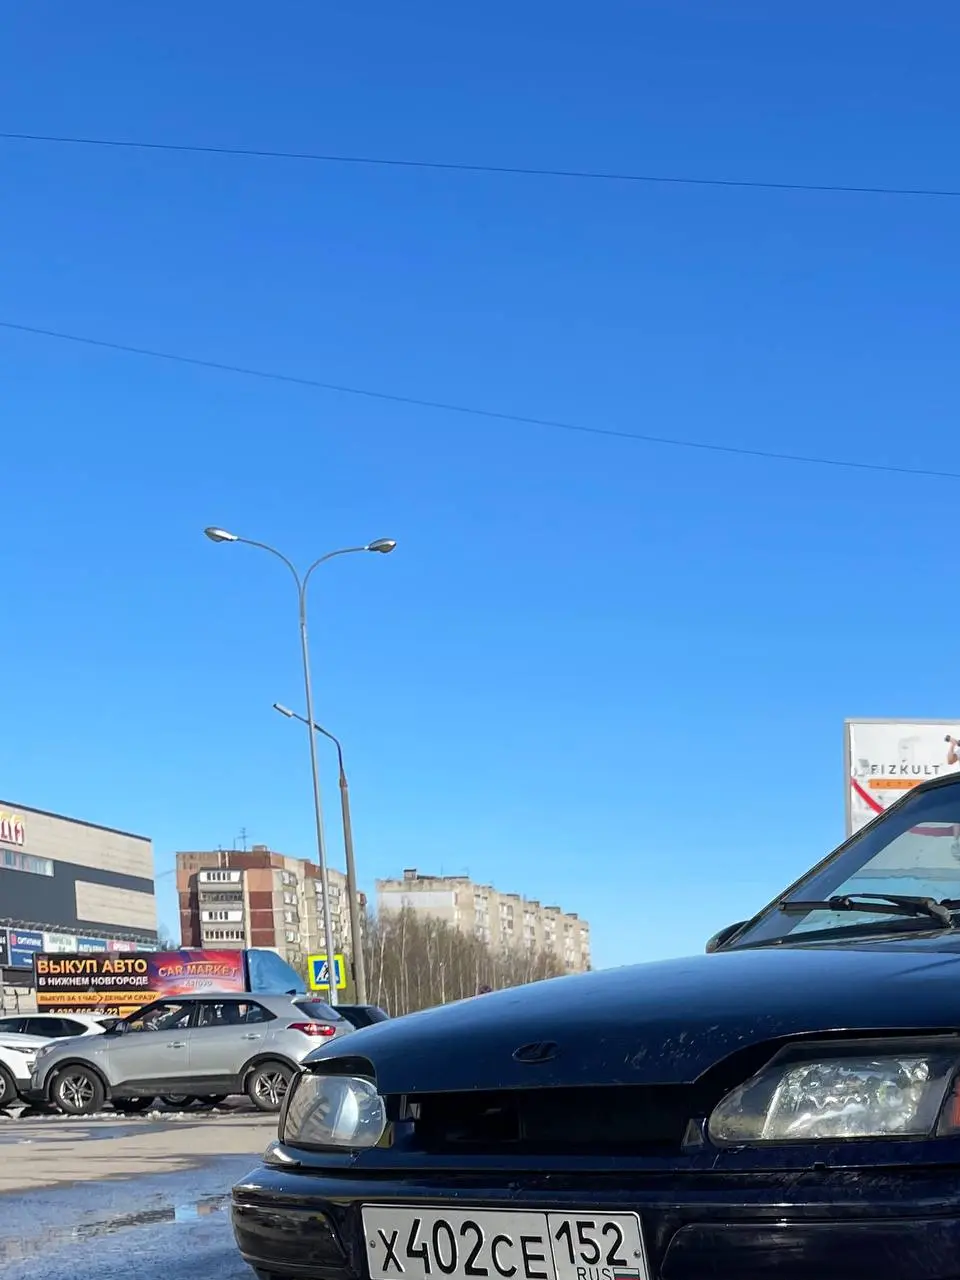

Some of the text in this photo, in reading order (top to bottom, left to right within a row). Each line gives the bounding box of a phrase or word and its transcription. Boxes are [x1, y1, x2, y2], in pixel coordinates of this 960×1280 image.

[870, 764, 940, 775] FIZKULT
[37, 959, 148, 974] ВЫКУП АВТО
[158, 964, 238, 978] CAR MARKET
[39, 976, 148, 987] В НИЖНЕМ НОВГОРОДЕ
[104, 993, 156, 1002] ДЕНЬГИ СРАЗУ
[554, 1220, 628, 1266] 152
